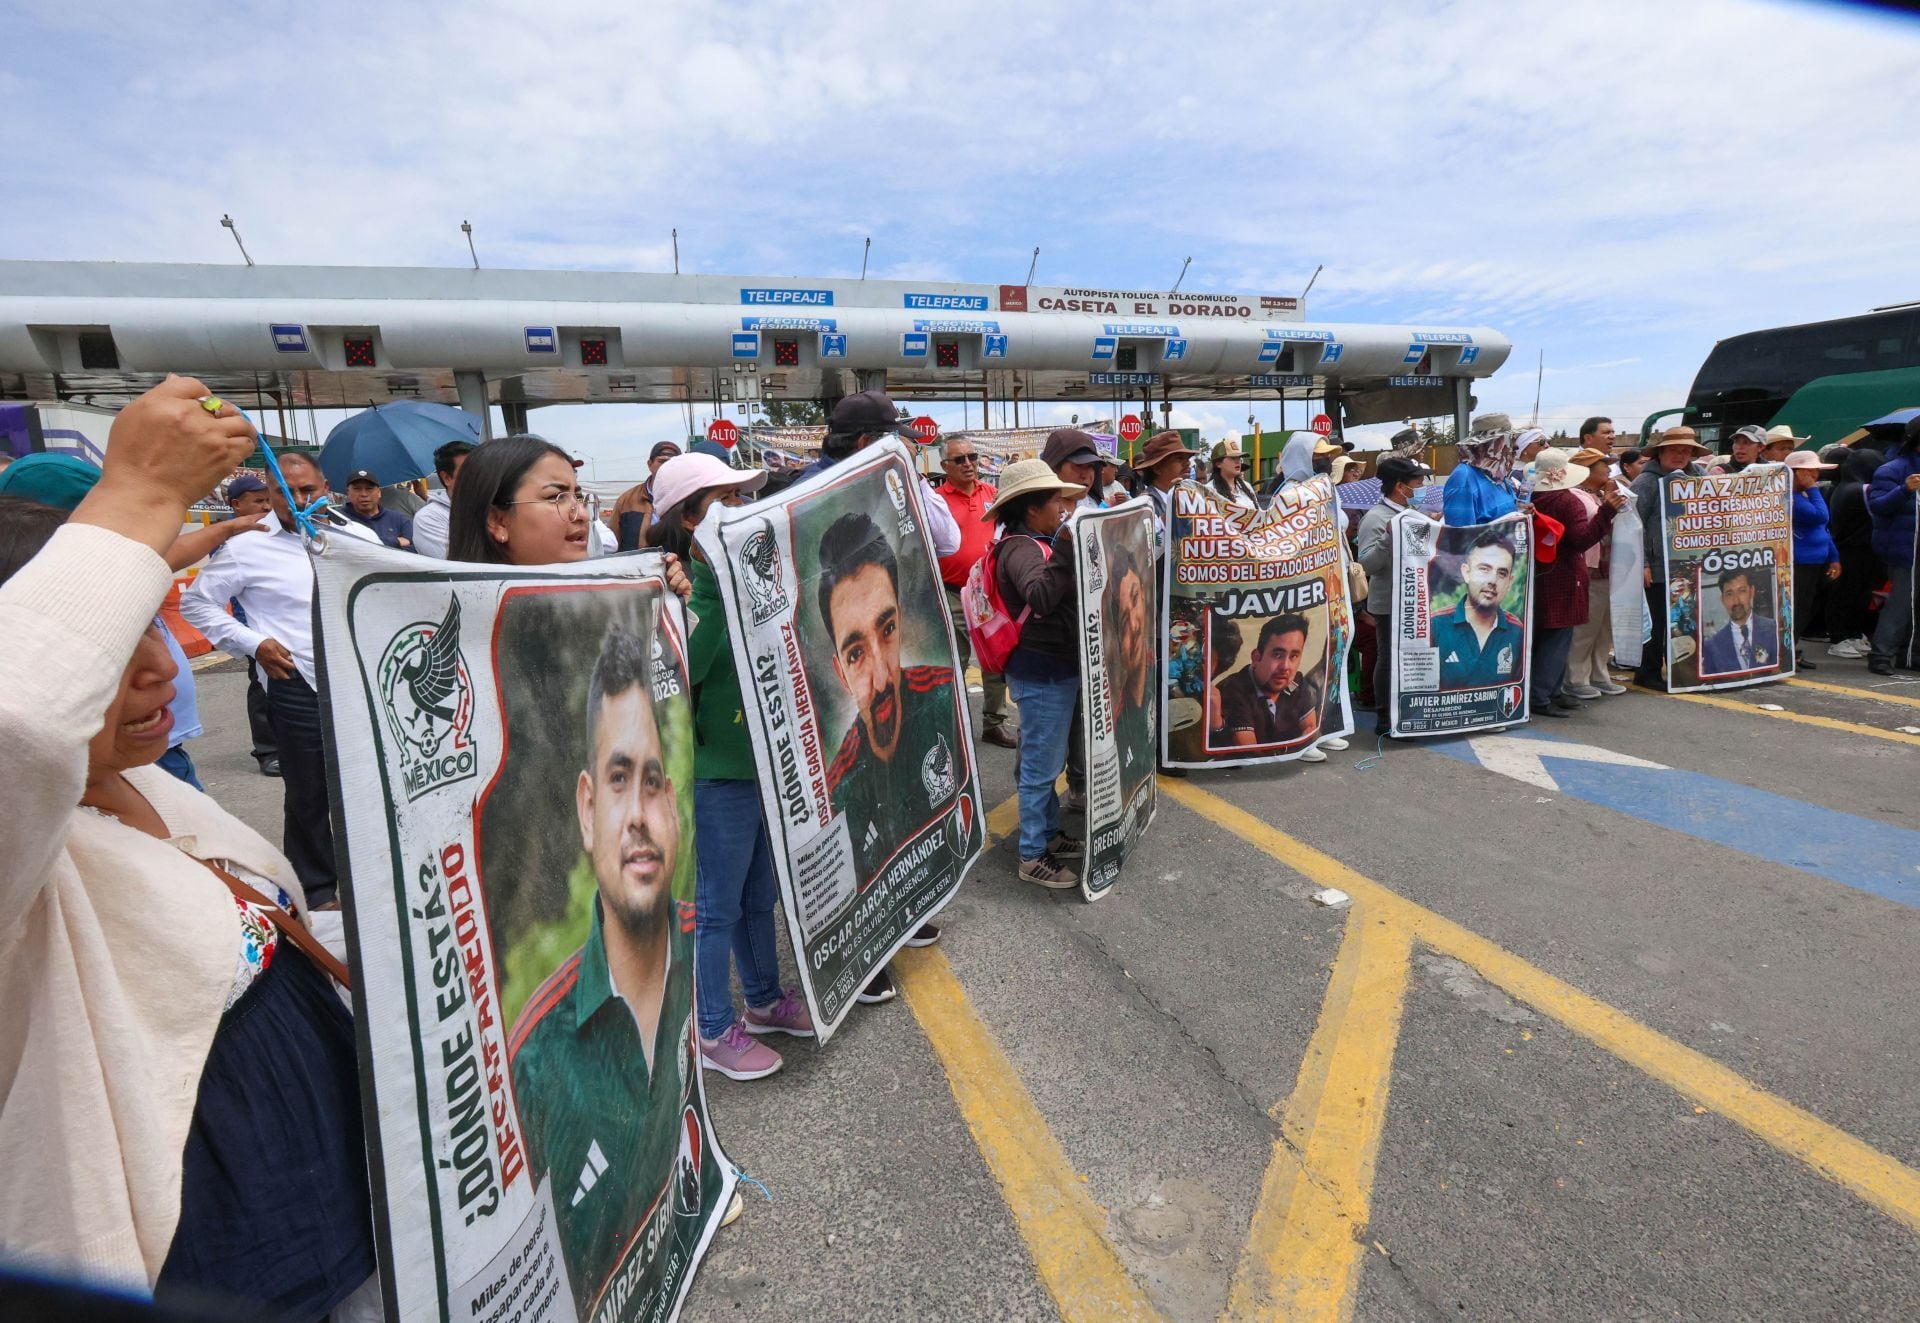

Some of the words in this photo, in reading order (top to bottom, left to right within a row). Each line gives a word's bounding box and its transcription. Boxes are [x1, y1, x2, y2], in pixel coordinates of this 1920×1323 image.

[747, 291, 826, 304] TELEPEAJE
[910, 295, 982, 309] TELEPEAJE
[1038, 297, 1118, 314] CASETA
[1134, 302, 1158, 315] EL
[1168, 303, 1251, 317] DORADO
[1063, 289, 1120, 299] AUTOPISTA
[1121, 292, 1160, 300] TOLUCA
[1167, 293, 1238, 303] ATLACOMULCO
[750, 323, 830, 332] RESIDENTES
[758, 317, 820, 325] EFECTIVO
[1109, 325, 1174, 335] TELEPEAJE
[1272, 330, 1329, 339] TELEPEAJE
[1417, 333, 1467, 341] TELEPEAJE
[1089, 373, 1160, 385] TELEPEAJE
[1250, 375, 1313, 386] TELEPEAJE
[1388, 376, 1444, 386] TELEPEAJE
[711, 428, 737, 441] ALTO
[914, 424, 936, 437] ALTO
[1120, 422, 1140, 433] ALTO
[1313, 421, 1331, 432] ALTO
[1671, 470, 1786, 501] MAZATLÁN
[1773, 496, 1780, 507] A
[1320, 506, 1328, 522] A
[1679, 513, 1753, 531] NUESTROS
[1754, 509, 1785, 524] HIJOS
[1296, 523, 1334, 550] HIJOS
[1674, 534, 1711, 549] SOMOS
[1712, 532, 1731, 545] DEL
[1732, 531, 1757, 544] ESTADO
[1757, 530, 1766, 541] DE
[1178, 565, 1228, 582] SOMOS
[1231, 564, 1257, 581] DEL
[1259, 560, 1302, 579] ESTADO
[1303, 556, 1314, 571] DE
[1703, 549, 1774, 573] ÓSCAR
[1402, 566, 1416, 598] ESTÁ?
[1214, 581, 1325, 616] JAVIER
[754, 598, 788, 623] MÉXICO
[1402, 599, 1415, 640] ¿DÓNDE
[1086, 609, 1101, 668] ESTÁ?
[661, 669, 675, 680] CUP
[780, 620, 810, 718] HERNÁNDEZ
[652, 677, 680, 703] 2026
[756, 647, 786, 731] ESTÁ?
[1409, 695, 1439, 708] JAVIER
[1441, 691, 1473, 706] RAMÍREZ
[1473, 689, 1498, 702] SABINO
[1091, 669, 1105, 742] ¿DÓNDE
[1441, 719, 1458, 727] MÉXICO
[798, 718, 821, 777] GARCÍA
[403, 750, 473, 796] MÉXICO
[773, 732, 810, 827] ¿DÓNDE
[811, 776, 829, 829] OSCAR
[797, 851, 814, 867] Miles
[800, 868, 823, 889] México
[801, 889, 812, 900] No
[812, 879, 824, 892] son
[804, 899, 816, 911] son
[813, 919, 853, 971] OSCAR
[854, 880, 890, 930] GARCÍA
[887, 827, 946, 890] HERNÁNDEZ
[805, 908, 818, 921] Son
[842, 946, 853, 961] NO
[853, 934, 863, 949] ES
[887, 898, 896, 913] ES
[895, 866, 929, 904] AUSENCIA
[411, 852, 468, 1023] ESTÁ?
[835, 966, 854, 991] SINCE
[873, 924, 896, 956] MÉXICO
[914, 889, 937, 915] ¿DÓNDE
[935, 873, 952, 895] ESTÁ?
[839, 976, 857, 1000] 202X
[438, 1019, 500, 1228] ¿DÓNDE
[599, 1243, 646, 1323] MÍREZ
[663, 1251, 681, 1293] ESTÁ?
[471, 1272, 508, 1317] Miles
[508, 1254, 523, 1278] de
[522, 1276, 546, 1313] cada
